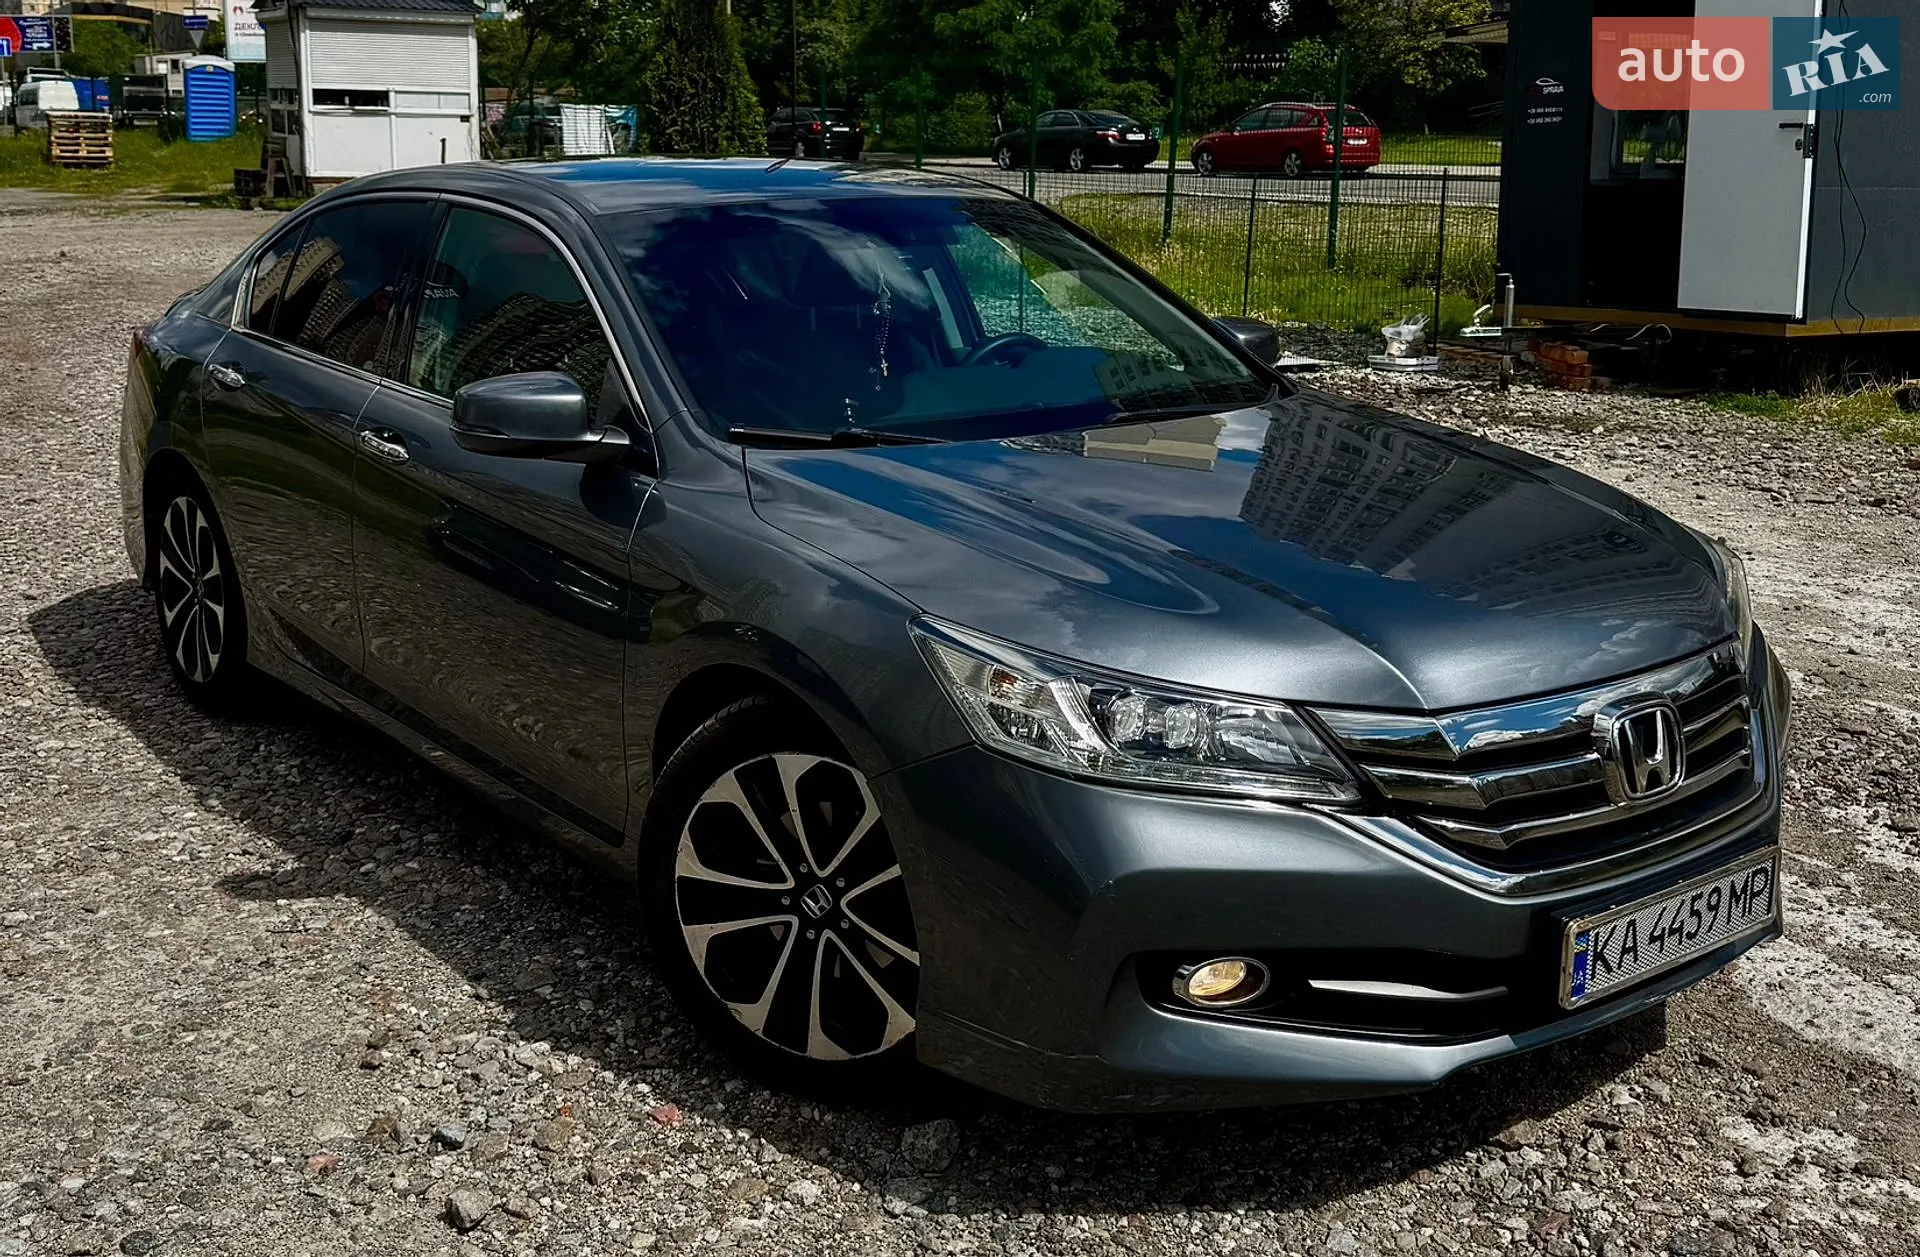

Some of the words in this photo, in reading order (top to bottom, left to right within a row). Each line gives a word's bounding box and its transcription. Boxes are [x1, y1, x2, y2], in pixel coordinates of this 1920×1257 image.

[1590, 917, 1639, 980] KA
[1649, 885, 1722, 954] 4459
[1726, 866, 1769, 926] MP
